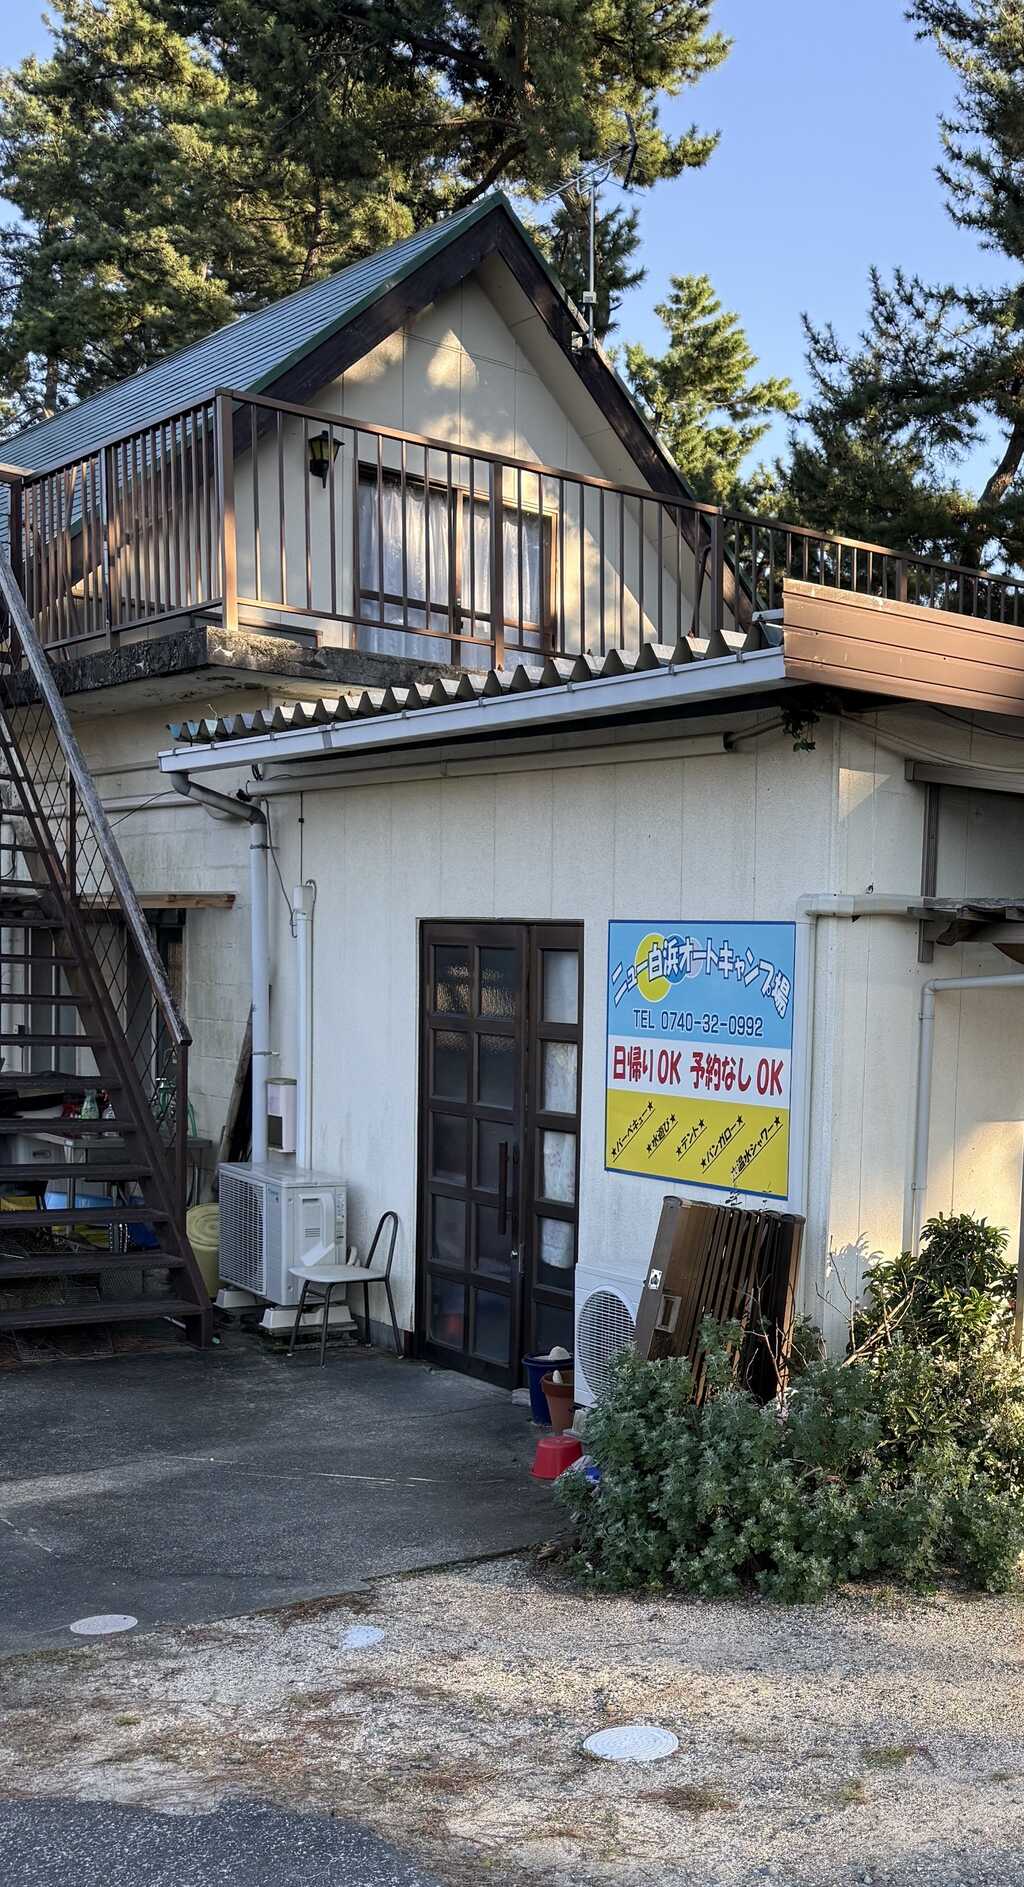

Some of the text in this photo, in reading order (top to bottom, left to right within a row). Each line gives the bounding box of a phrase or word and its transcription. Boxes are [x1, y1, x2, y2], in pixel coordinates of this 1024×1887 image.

[611, 936, 791, 1019] ニュー白浜オートキャンプ場
[633, 1009, 763, 1036] TEL 0740-32-0992
[651, 1118, 670, 1148] 水遊び
[681, 1125, 700, 1149] テント
[735, 1124, 774, 1173] 温水シャワー
